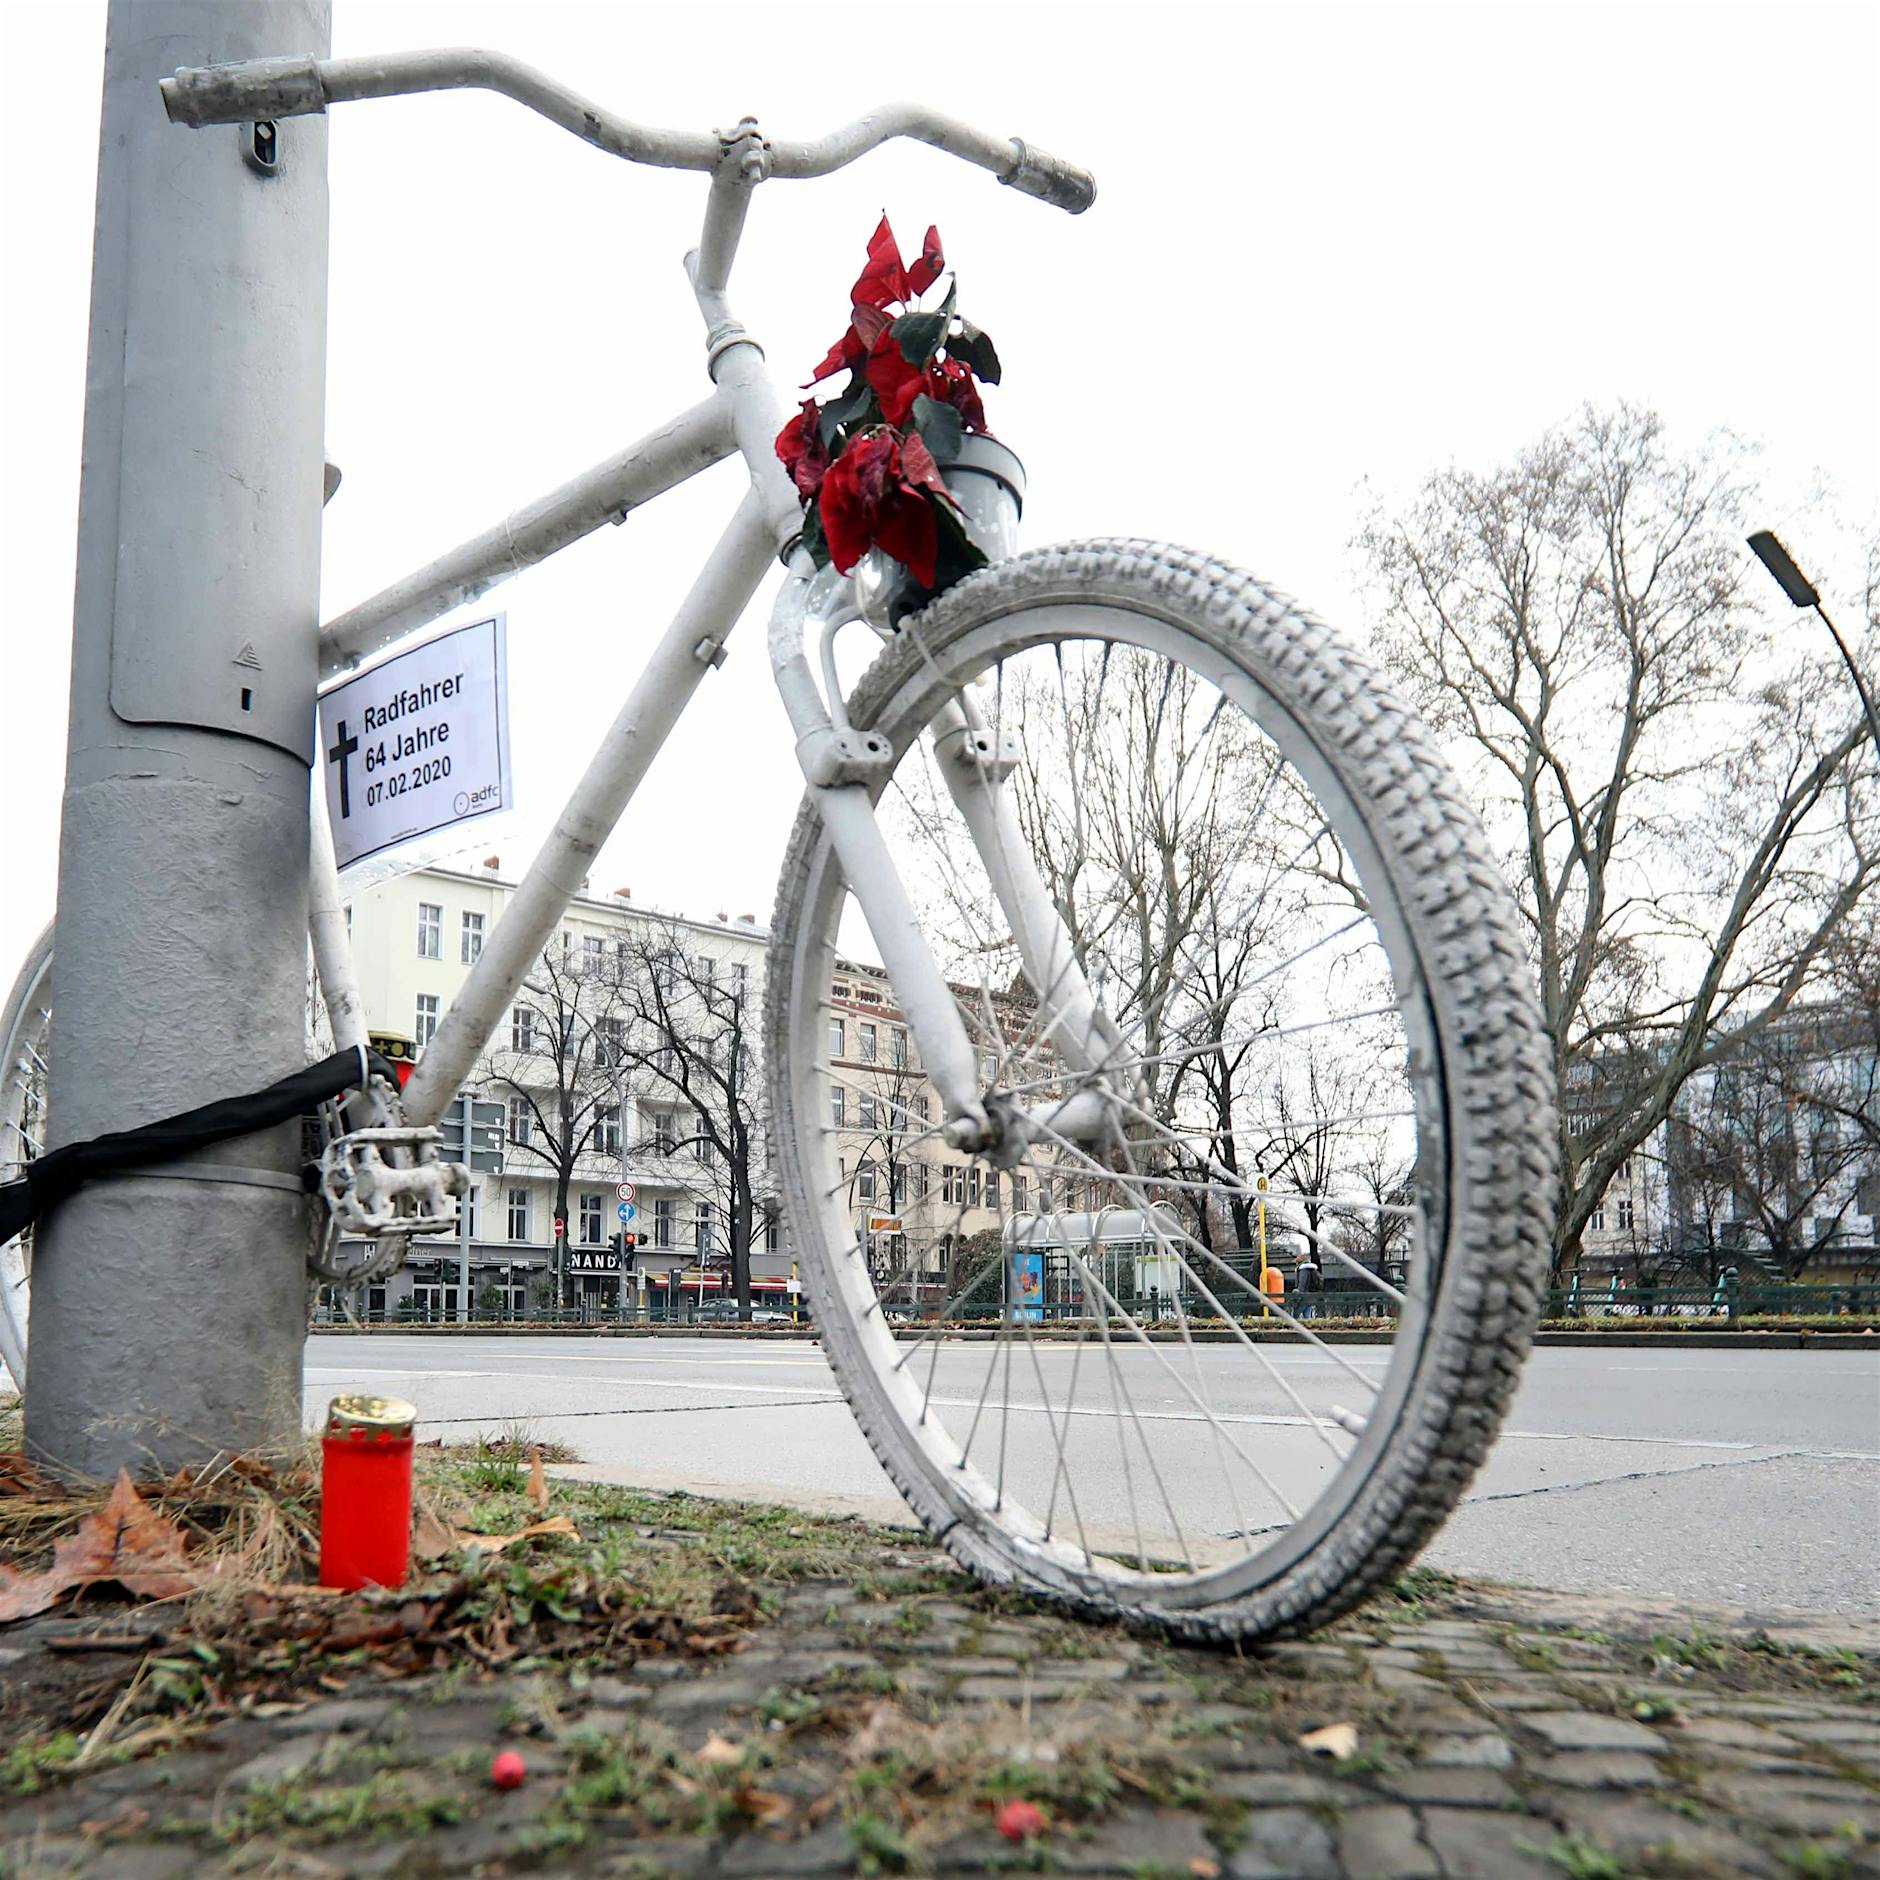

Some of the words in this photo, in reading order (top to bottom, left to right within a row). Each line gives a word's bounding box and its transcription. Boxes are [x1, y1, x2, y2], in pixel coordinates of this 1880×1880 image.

[364, 673, 463, 733] Radfahrer
[366, 742, 386, 772] 64
[392, 723, 449, 761] Jahre
[367, 756, 451, 807] 07.02.2020
[471, 784, 499, 803] adfc
[621, 1187, 631, 1197] 50
[571, 1253, 621, 1268] NAND
